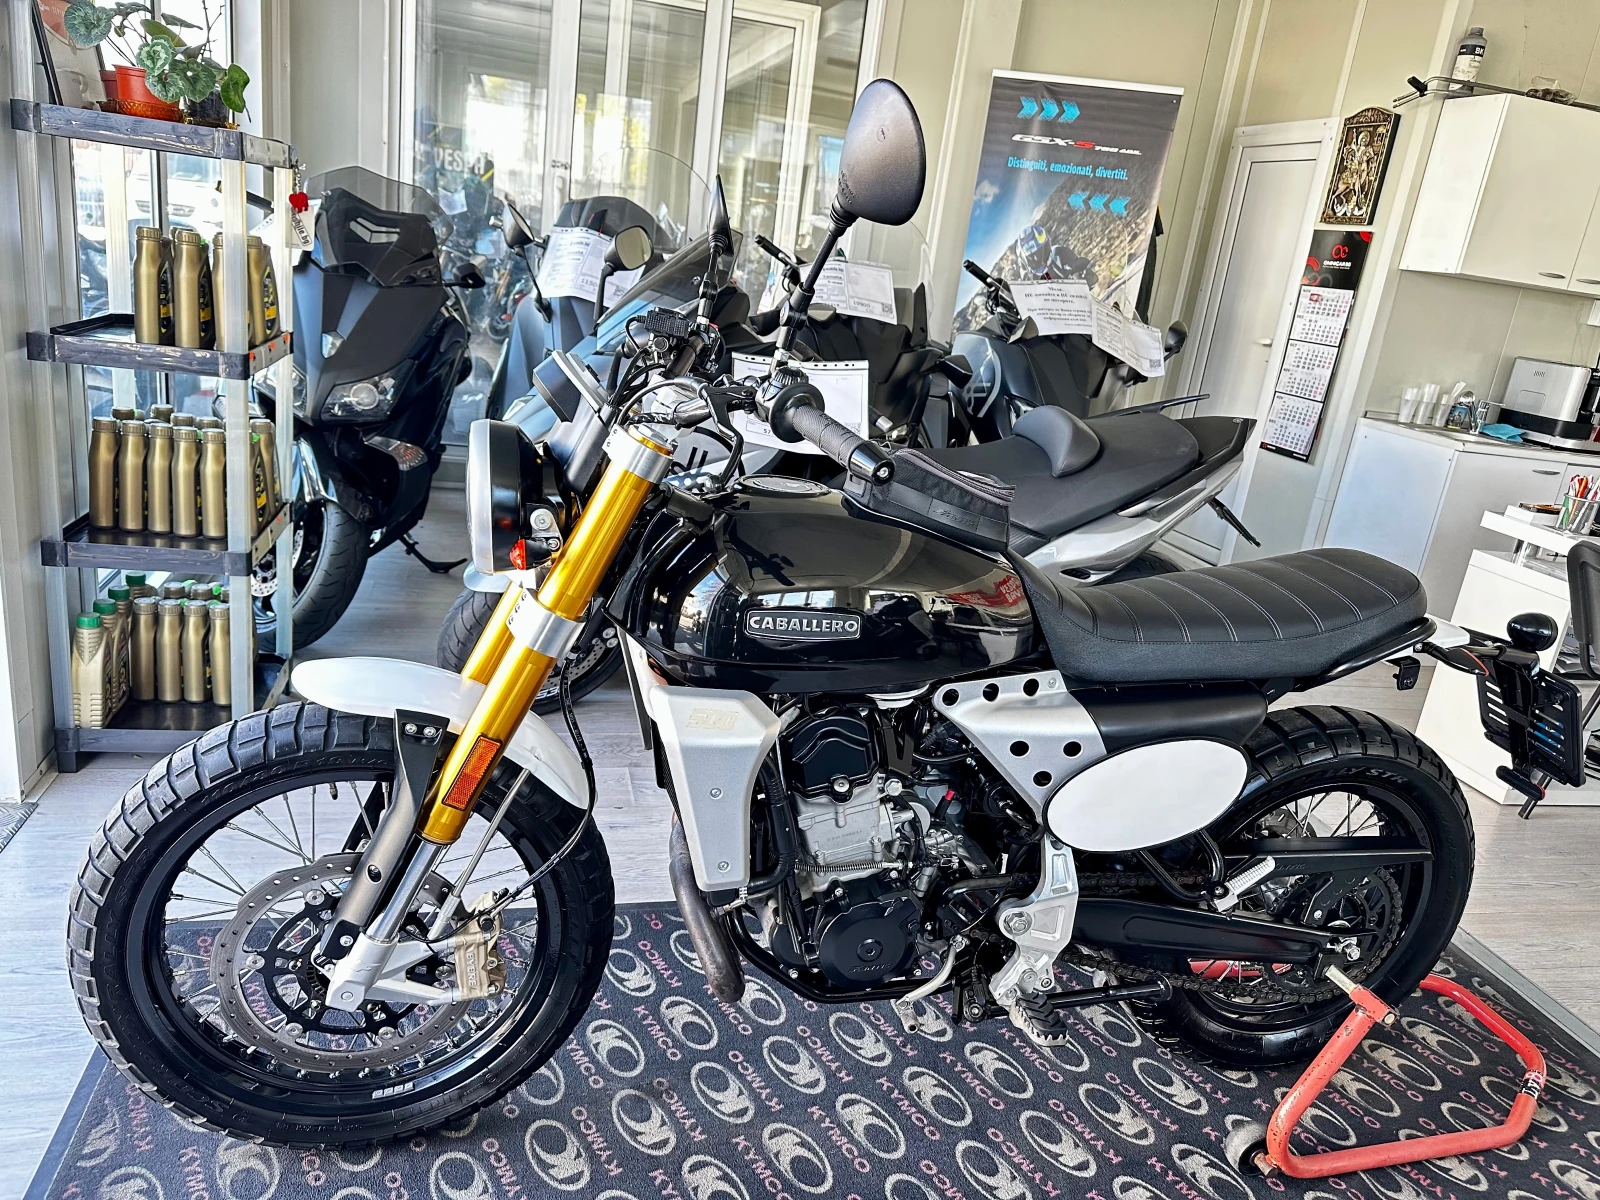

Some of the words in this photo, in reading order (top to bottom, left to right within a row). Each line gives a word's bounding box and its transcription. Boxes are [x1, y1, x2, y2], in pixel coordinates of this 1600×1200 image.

[1008, 156, 1048, 172] Distinguiti,
[1050, 162, 1094, 178] emozionati,
[1095, 168, 1128, 181] divertiti.
[1012, 134, 1095, 149] GSX-S
[749, 616, 858, 633] CABALLERO
[686, 708, 739, 731] 500
[1366, 768, 1408, 784] STR
[637, 940, 683, 988] KYMCO
[633, 1004, 681, 1060] KYMCO
[703, 984, 752, 1036] KMCO
[860, 1002, 918, 1057] KYMCO
[566, 1034, 604, 1089] YMCO
[728, 1050, 784, 1112] KYMCO
[796, 1025, 853, 1083] KYMCO
[940, 1051, 1005, 1110] KYMCO
[998, 1027, 1063, 1083] KYMCO
[1534, 1043, 1598, 1083] YMCO
[653, 1078, 707, 1142] KYMCO
[876, 1077, 940, 1140] KYMCO
[1105, 1072, 1179, 1131] KYMCO
[571, 1106, 623, 1176] KYMCO
[808, 1105, 870, 1173] KYMCO
[1049, 1100, 1122, 1163] KYMCO
[178, 1146, 209, 1200] KYMC
[482, 1137, 526, 1200] YMCO
[987, 1128, 1060, 1197] KYMCO
